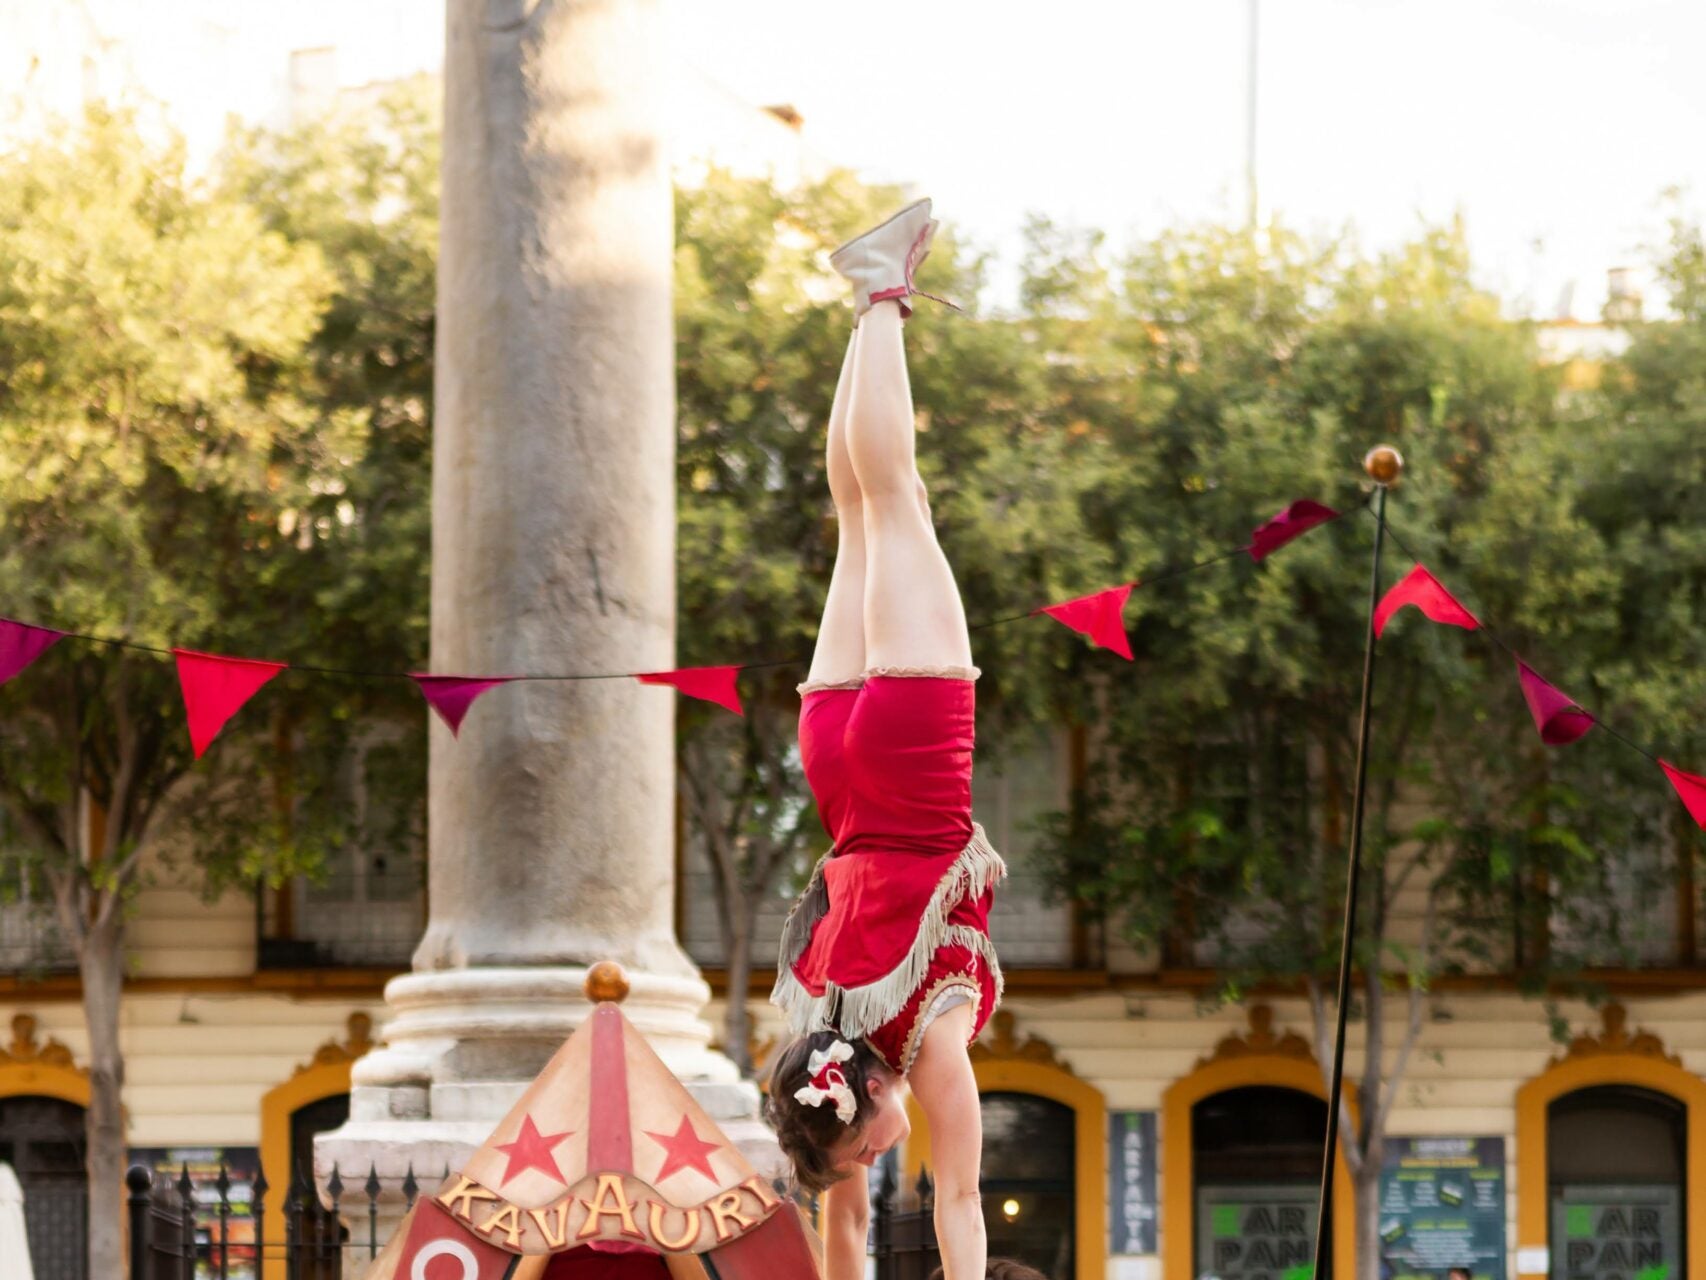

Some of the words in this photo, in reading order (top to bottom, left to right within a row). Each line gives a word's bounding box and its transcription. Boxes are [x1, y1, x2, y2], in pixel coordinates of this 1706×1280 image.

[1124, 1112, 1144, 1254] ARPANTA
[435, 1173, 784, 1250] KAVAURI
[1212, 1205, 1307, 1236] AR
[1567, 1206, 1661, 1237] AR
[1213, 1239, 1310, 1271] PAN
[1567, 1240, 1664, 1271] PAN
